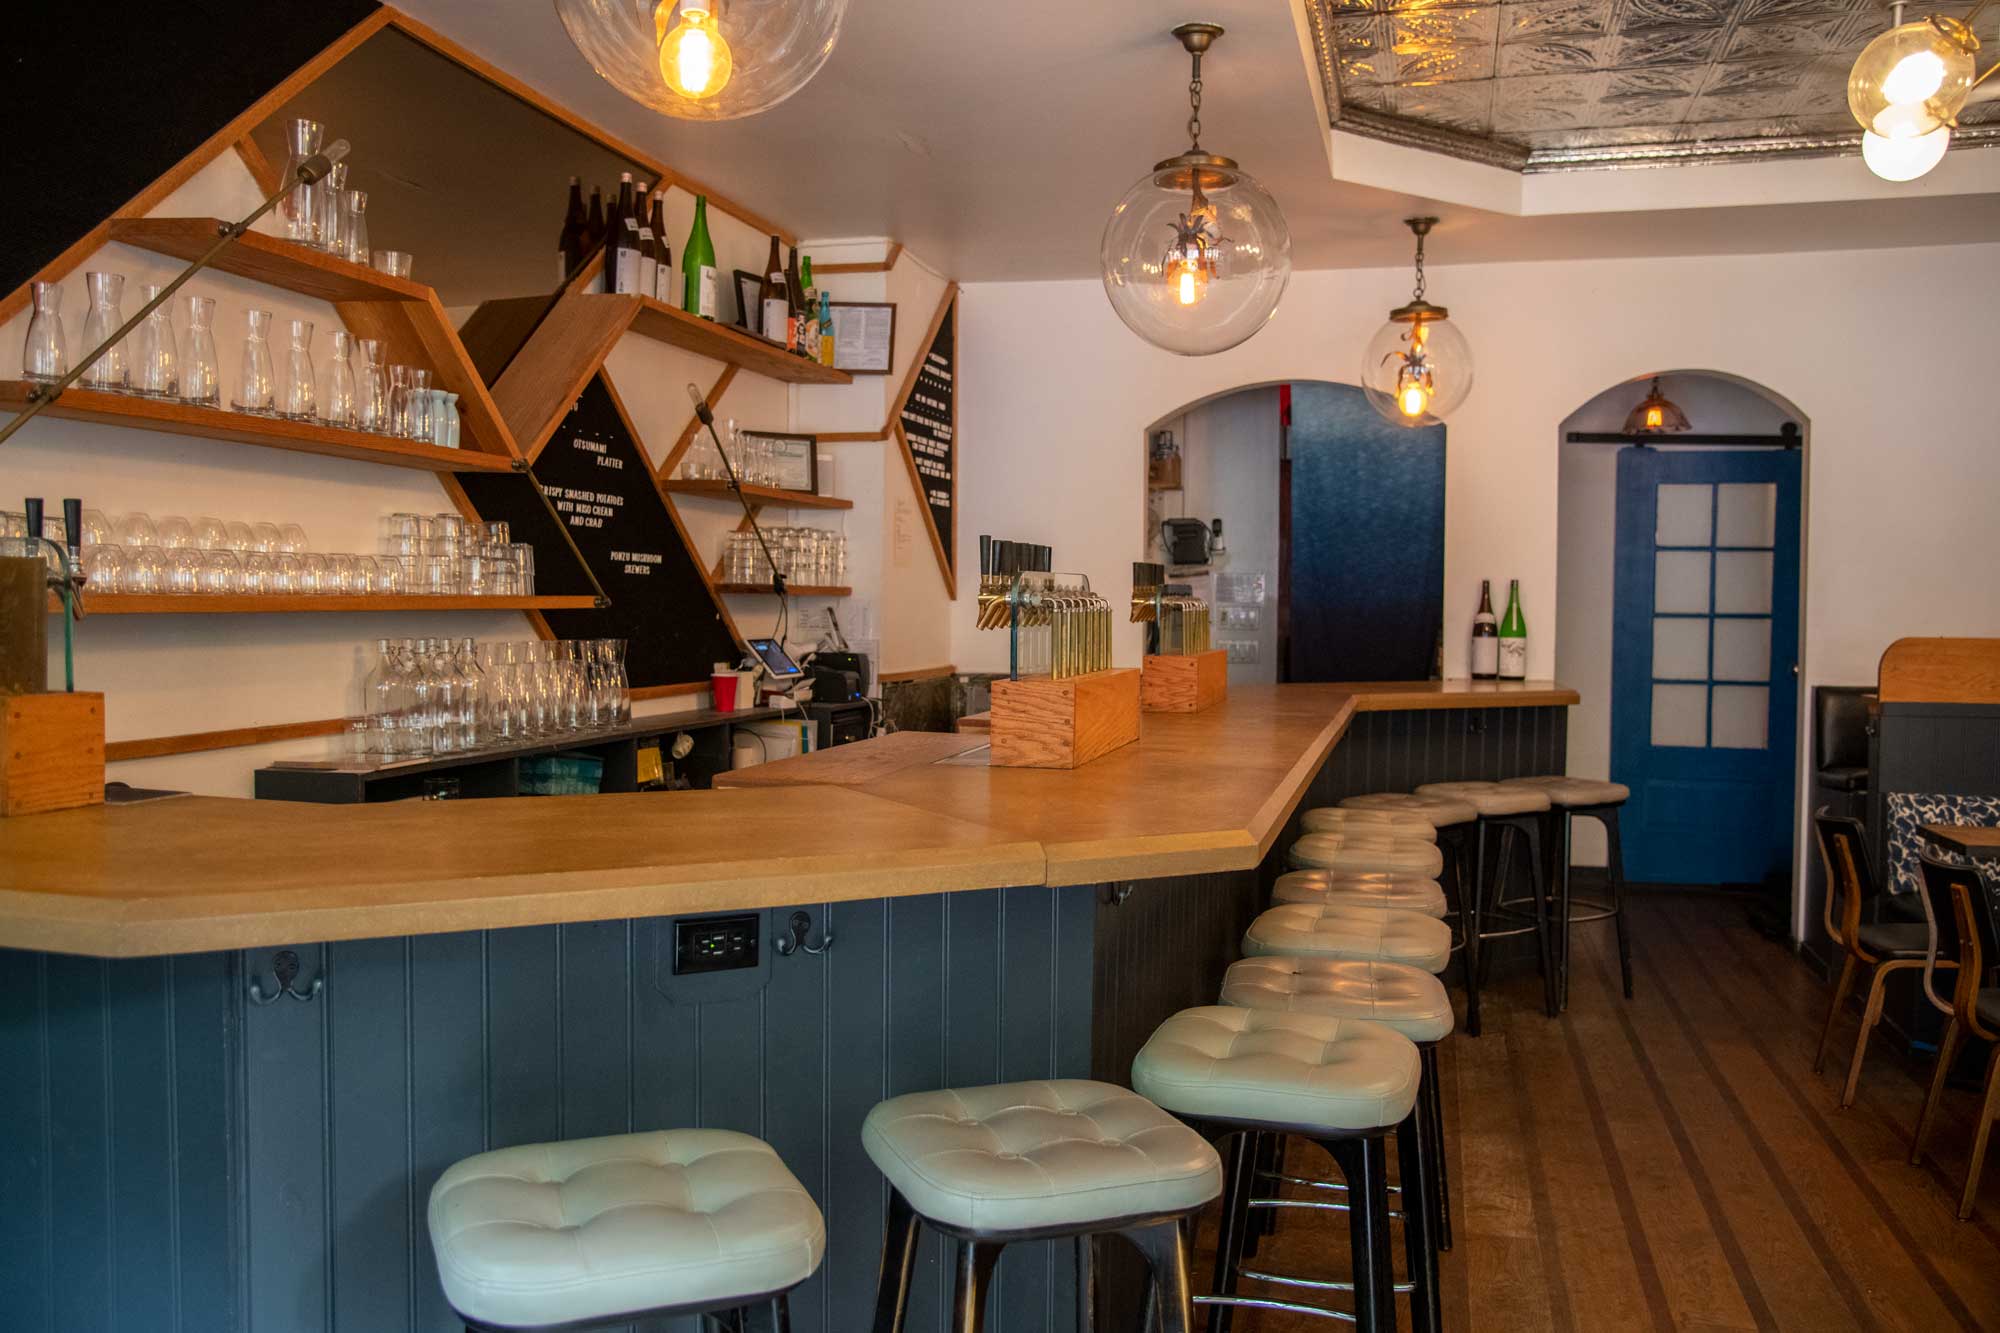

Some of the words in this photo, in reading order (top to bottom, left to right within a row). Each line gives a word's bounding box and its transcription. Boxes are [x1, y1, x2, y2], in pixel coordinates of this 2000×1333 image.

[597, 455, 623, 470] PLATTER
[564, 488, 595, 501] SMASHED
[596, 493, 624, 506] POTATOES
[557, 500, 574, 511] WITH
[576, 503, 592, 514] MISO
[592, 506, 614, 517] CREAM
[570, 515, 584, 526] AND
[585, 517, 603, 528] CRAB
[610, 551, 631, 561] PONZU
[631, 552, 662, 564] MUSHROOM
[624, 564, 650, 575] SKEWERS
